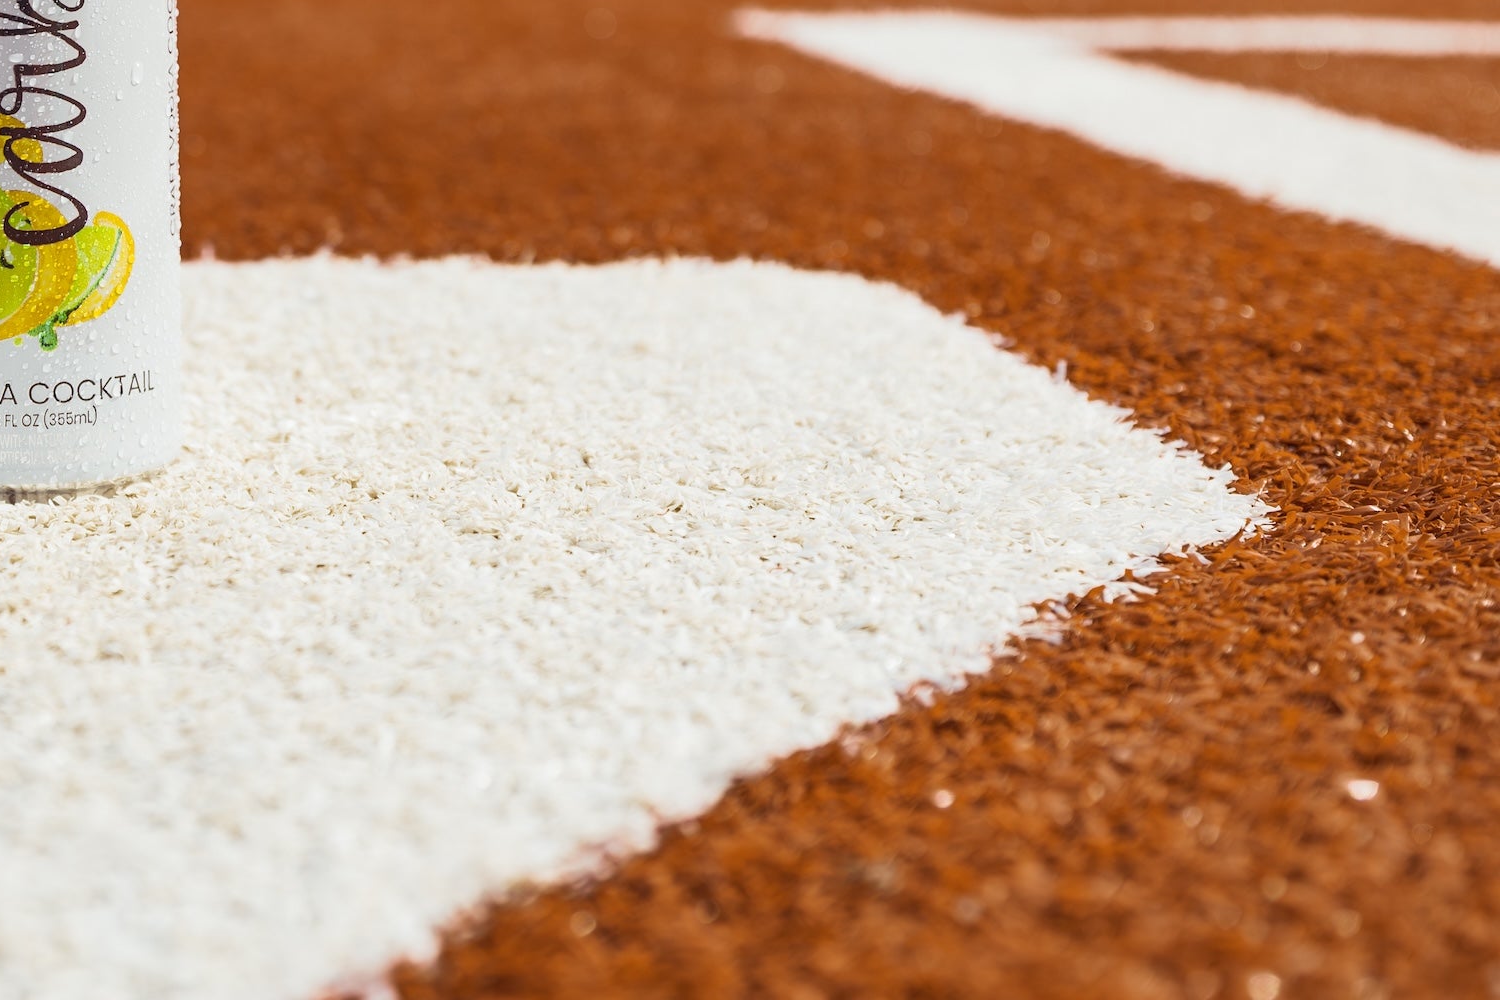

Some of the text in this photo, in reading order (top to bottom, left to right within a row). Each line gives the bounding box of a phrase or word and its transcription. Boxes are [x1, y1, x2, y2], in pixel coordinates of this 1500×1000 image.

[28, 369, 154, 406] COCKTAIL
[4, 414, 18, 428] FL
[21, 413, 40, 428] OZ
